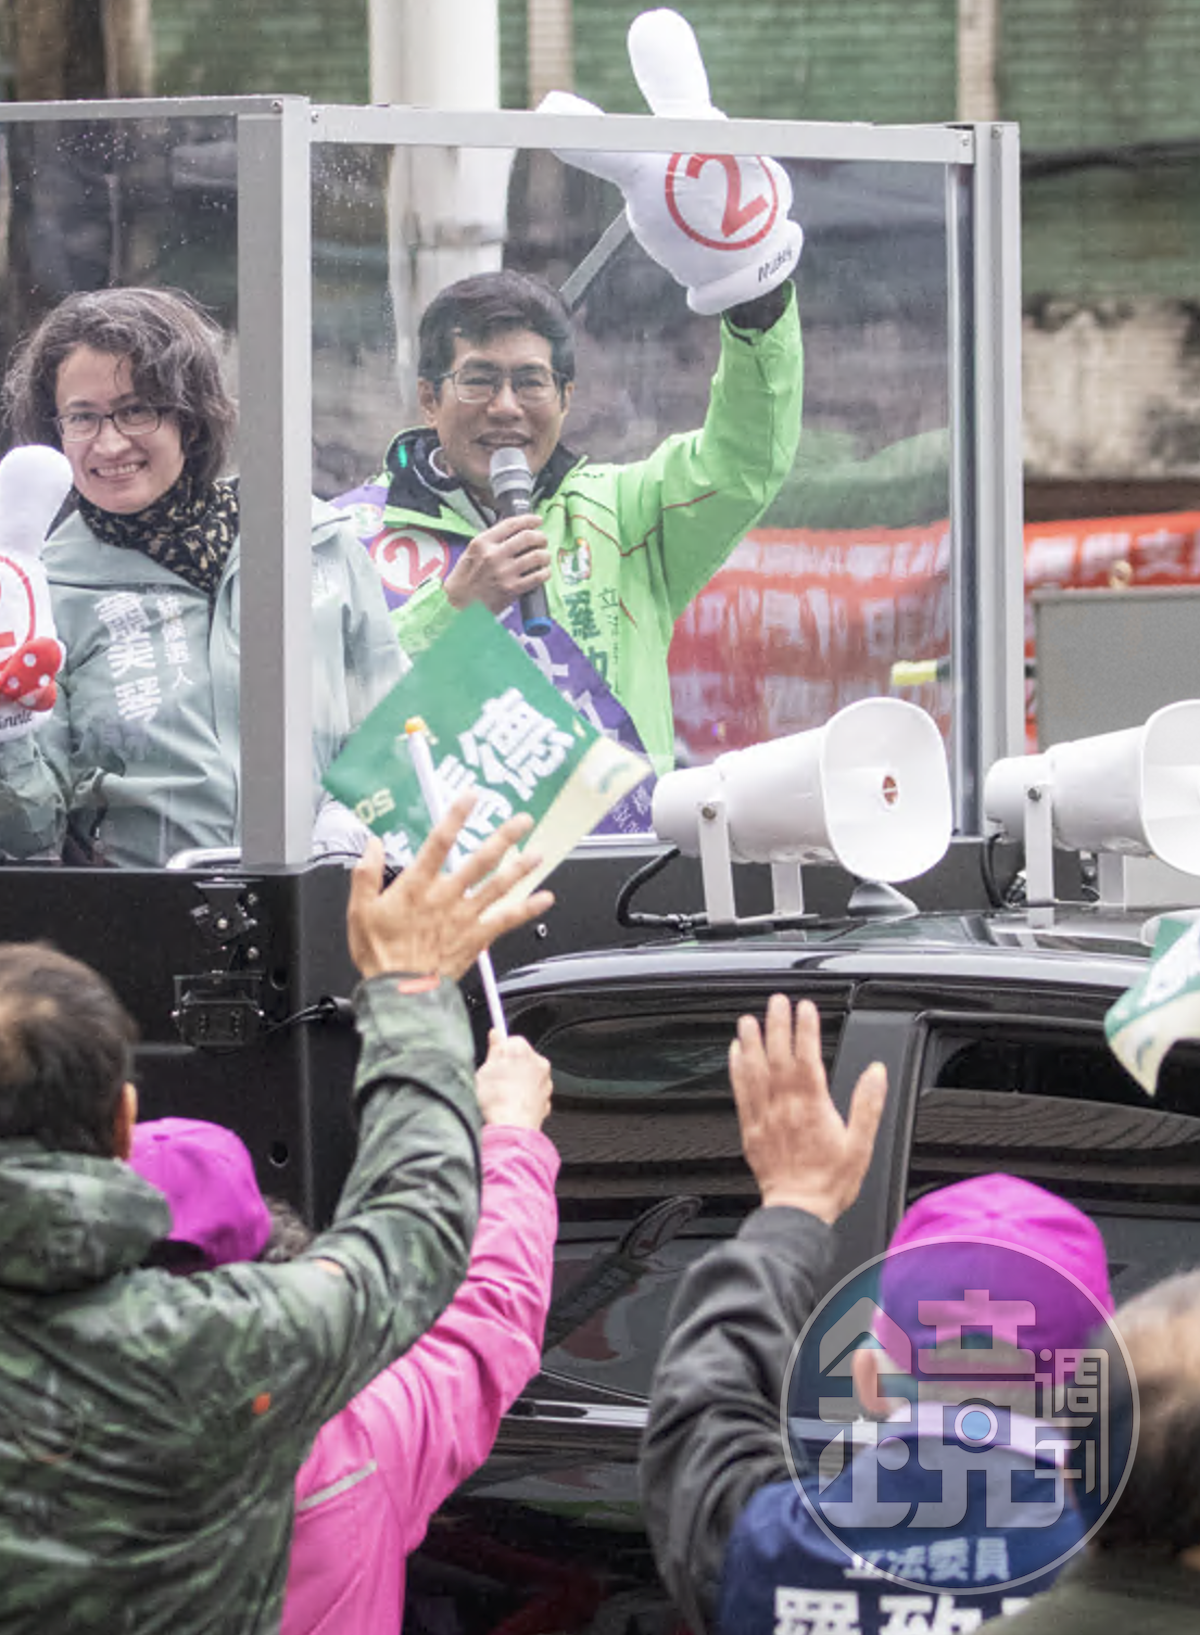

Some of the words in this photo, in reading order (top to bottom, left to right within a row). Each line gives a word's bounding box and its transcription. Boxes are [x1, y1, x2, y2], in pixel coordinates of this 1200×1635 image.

[685, 153, 769, 238] 2
[843, 1537, 1011, 1581] 立法委員
